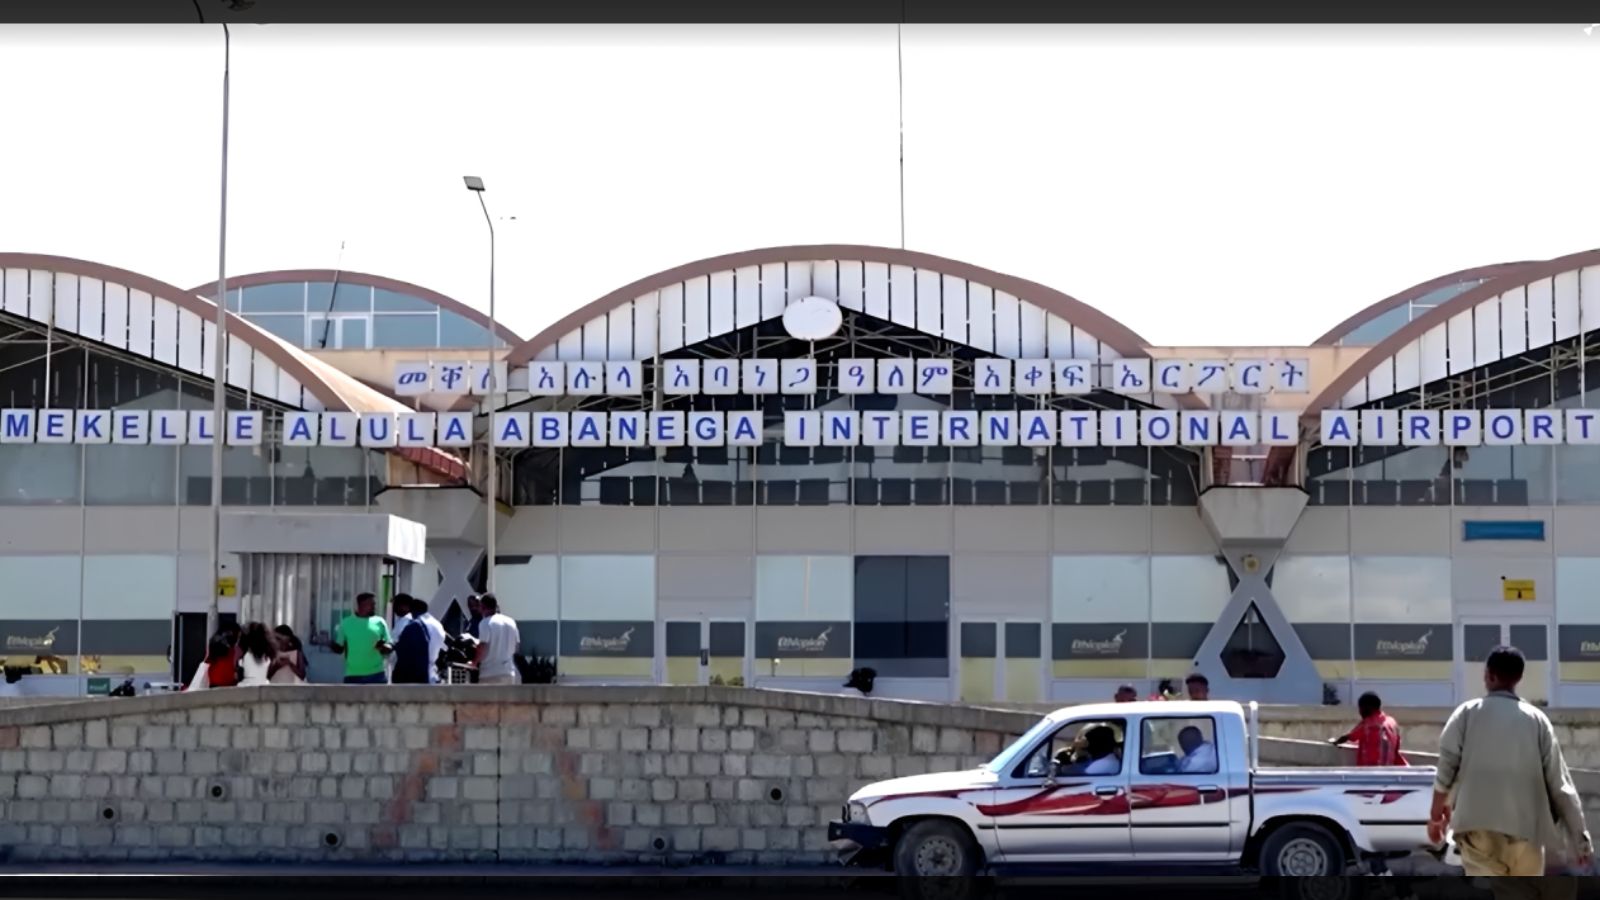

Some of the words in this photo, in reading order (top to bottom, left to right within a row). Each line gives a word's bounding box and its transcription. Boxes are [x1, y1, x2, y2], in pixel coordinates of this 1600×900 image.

[538, 365, 632, 390] አሉላ
[673, 364, 810, 388] አባነጋ
[848, 365, 949, 388] ዓለም
[983, 364, 1084, 388] አቀፍ
[1120, 360, 1304, 388] ኤርፖርት
[6, 413, 254, 440] MEKELLE
[289, 416, 466, 441] ALULA
[501, 416, 757, 441] ABANEGA
[799, 415, 1289, 441] INTERNATIONAL
[1328, 414, 1595, 440] AIRPORT
